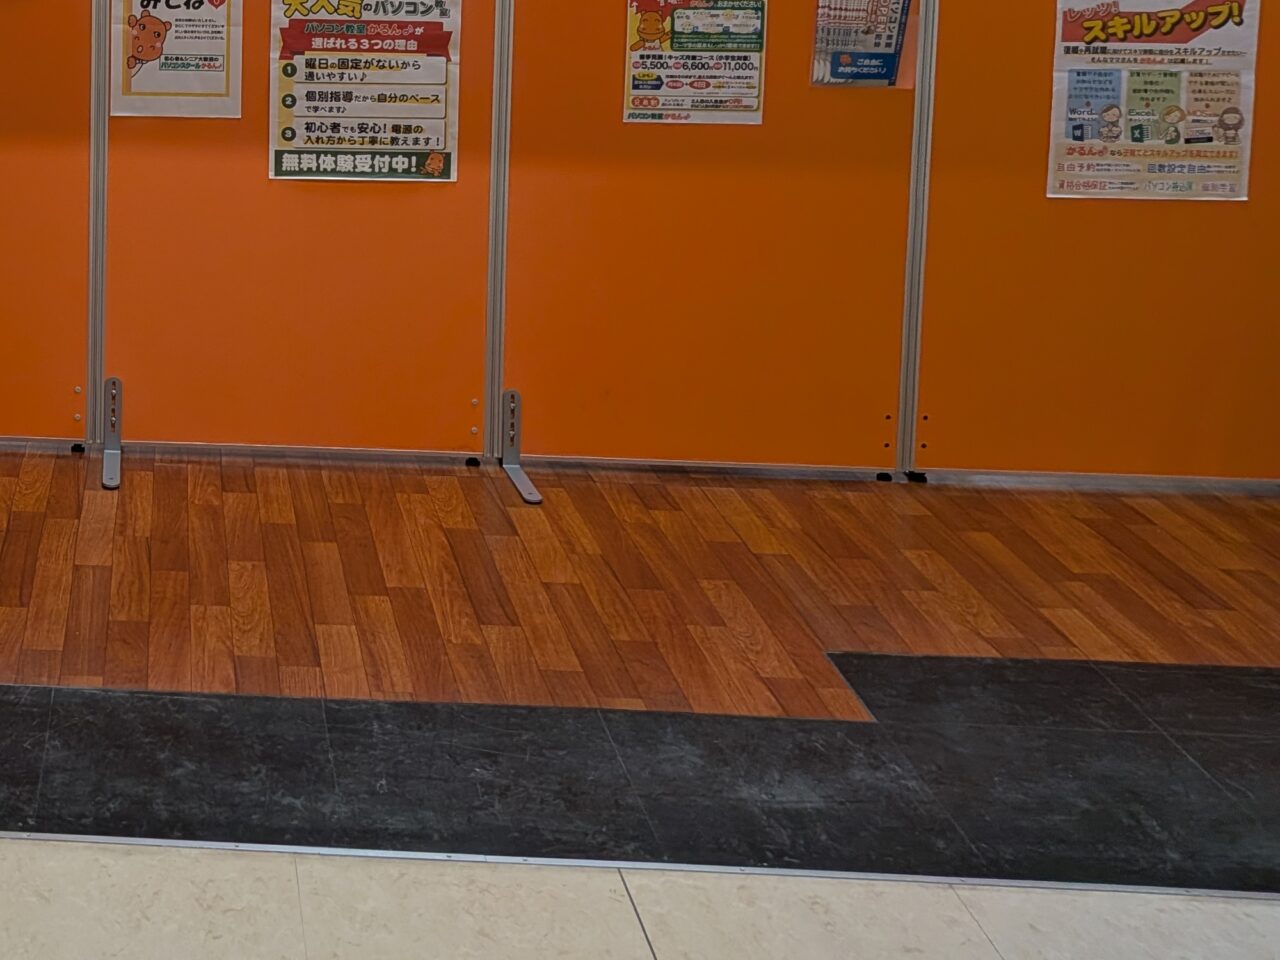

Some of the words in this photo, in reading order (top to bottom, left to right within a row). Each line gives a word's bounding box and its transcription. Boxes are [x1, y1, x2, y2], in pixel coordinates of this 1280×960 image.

[1082, 1, 1244, 45] スキルアップ!
[305, 58, 421, 71] 曜日の固定がないから
[305, 91, 441, 103] 個別指導だから自分のペース
[281, 153, 417, 173] 無料体験受付中!
